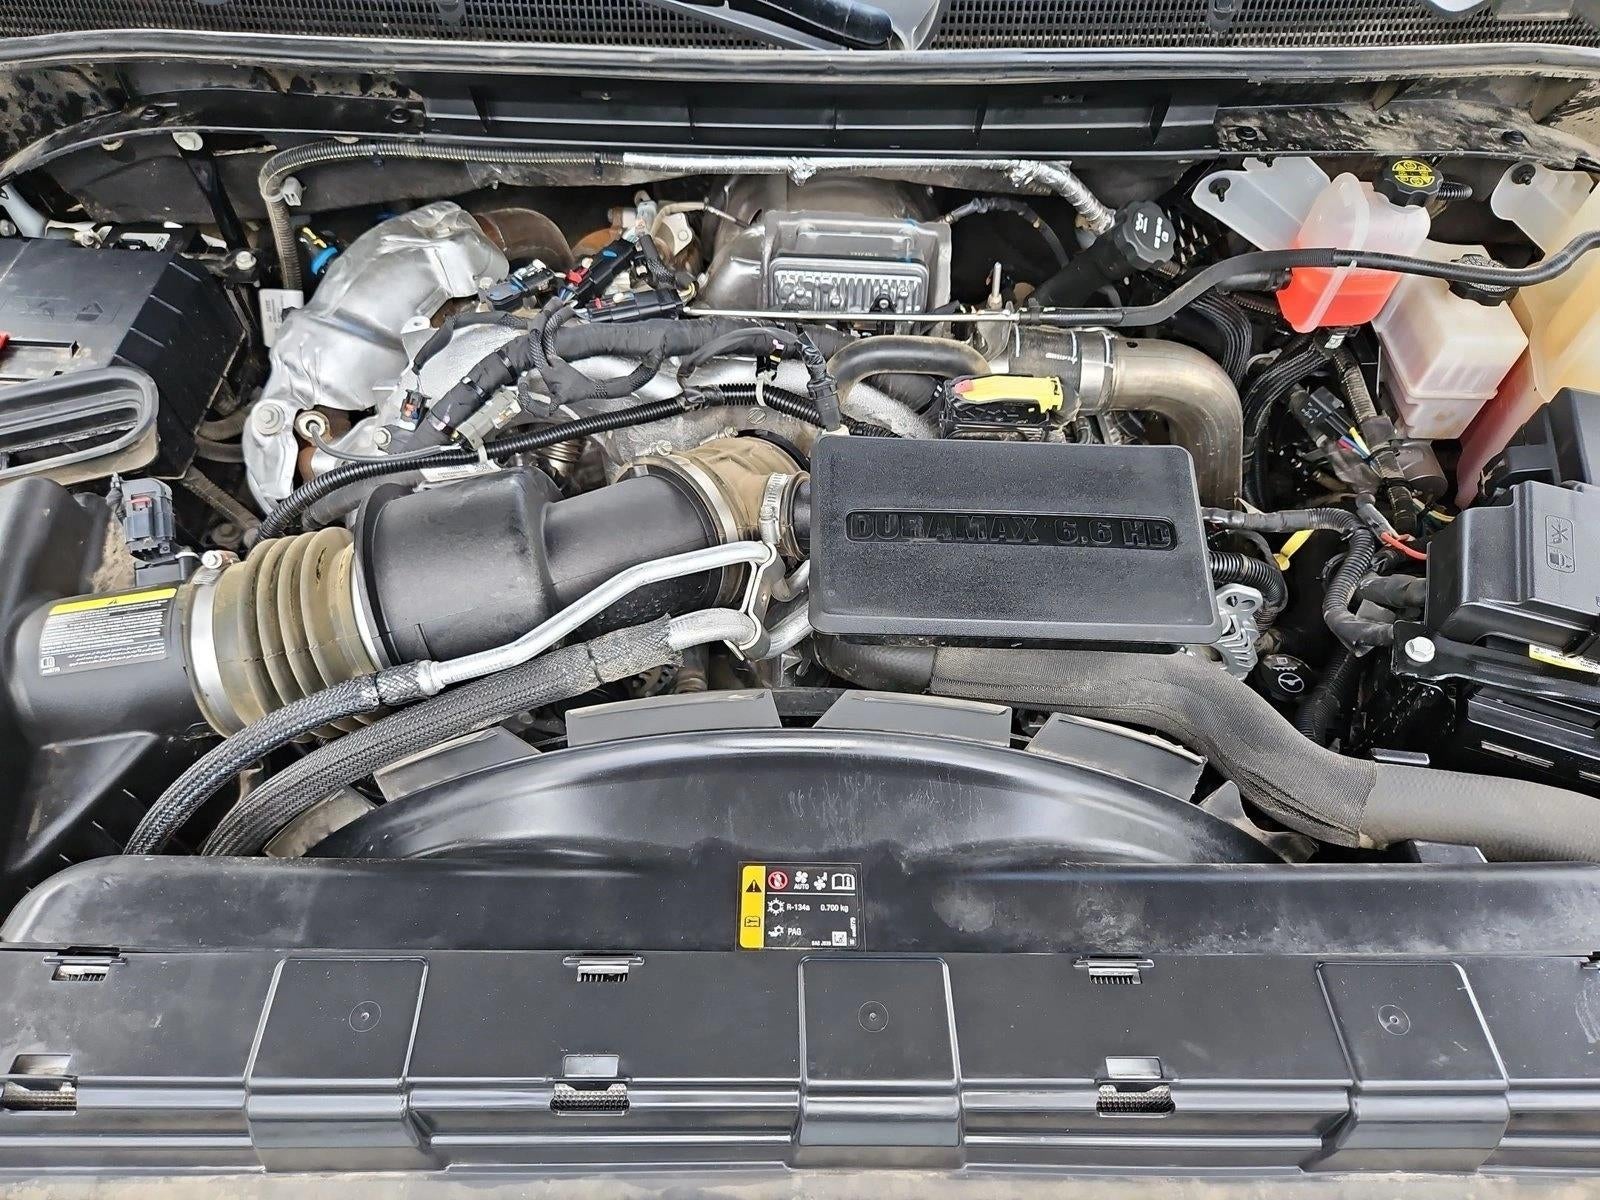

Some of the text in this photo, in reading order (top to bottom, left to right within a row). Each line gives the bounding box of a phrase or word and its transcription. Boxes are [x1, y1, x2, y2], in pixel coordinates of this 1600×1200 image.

[850, 513, 1172, 548] DURAMAX 6.6 HD
[786, 903, 849, 913] R-134a 0.700 kg
[787, 927, 802, 936] PAG
